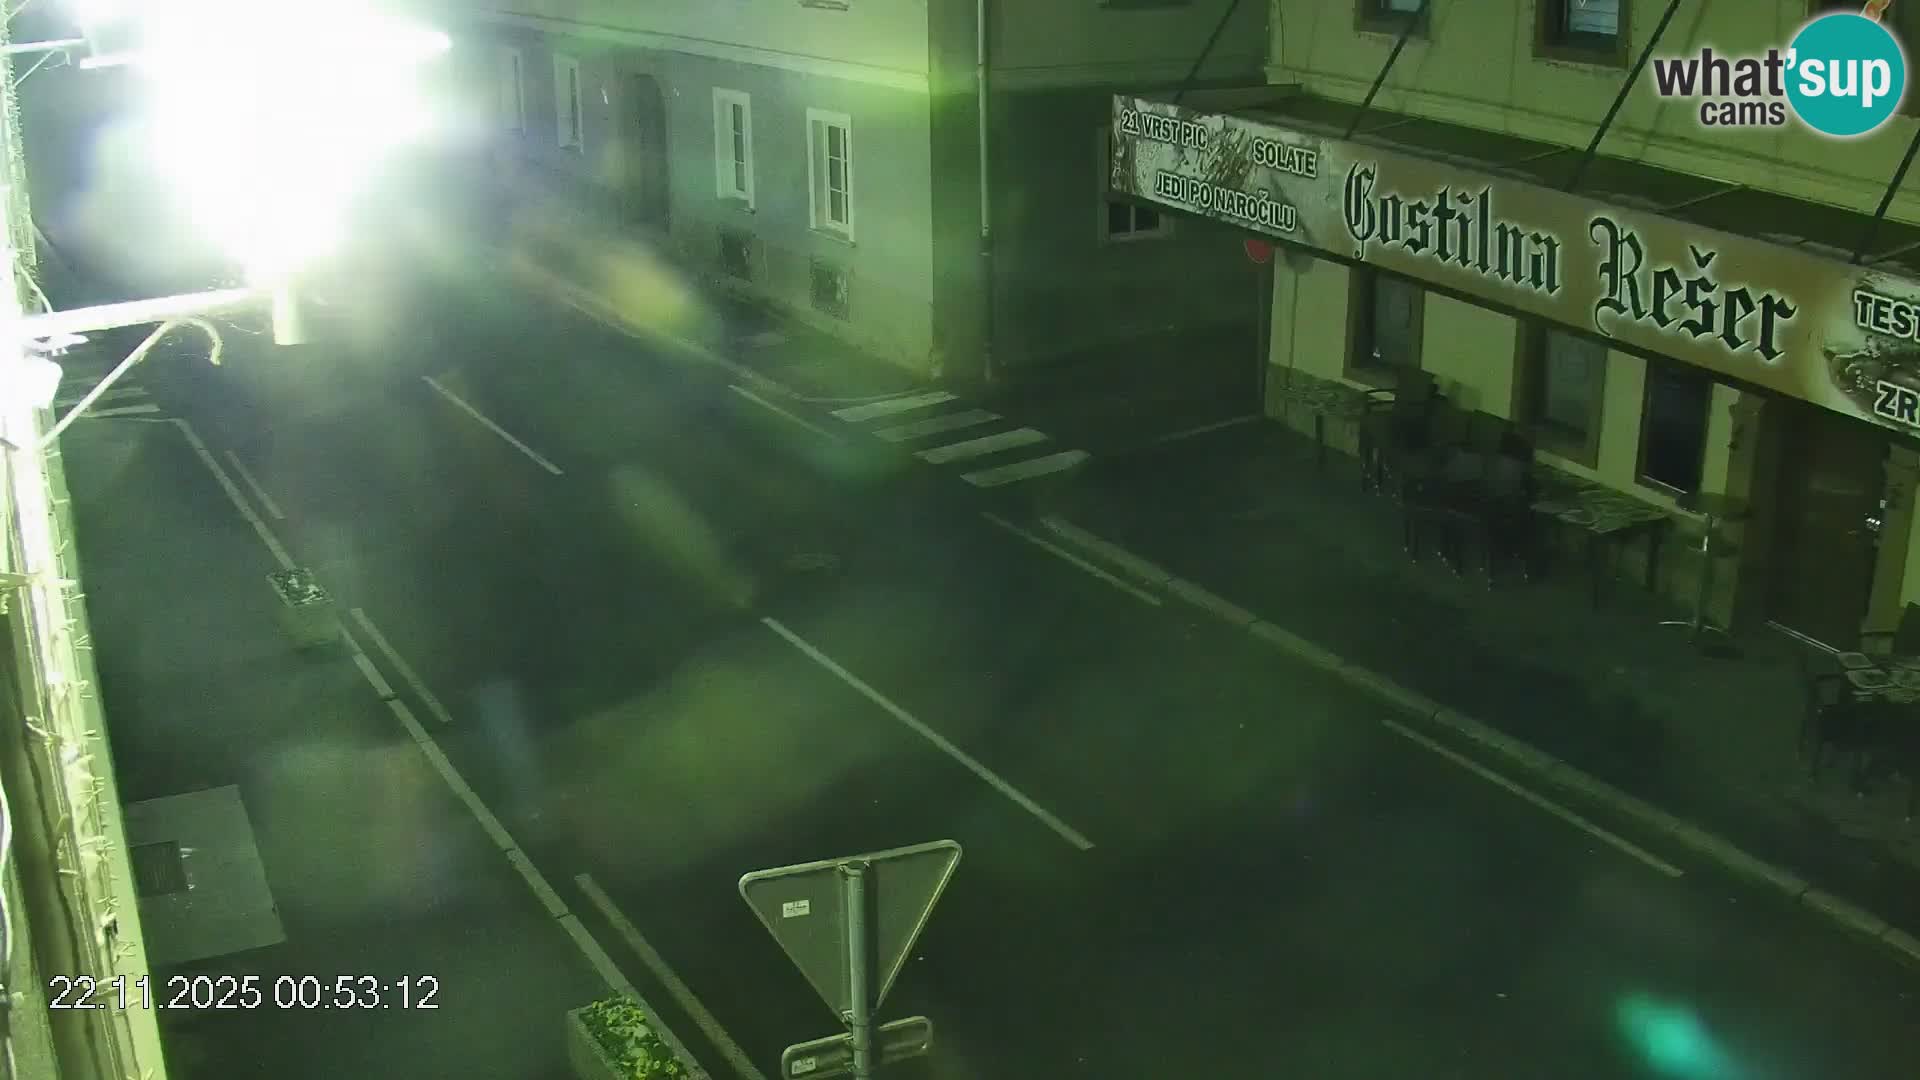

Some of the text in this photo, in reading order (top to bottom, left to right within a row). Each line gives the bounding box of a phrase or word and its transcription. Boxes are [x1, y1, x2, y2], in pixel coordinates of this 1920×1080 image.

[1121, 109, 1209, 150] 21 VRST PIC
[1253, 138, 1317, 178] SOLATE
[1155, 171, 1296, 231] JEDI PO NAROČILU
[1343, 160, 1799, 362] Gostilna Rešer
[1874, 380, 1920, 428] ZR
